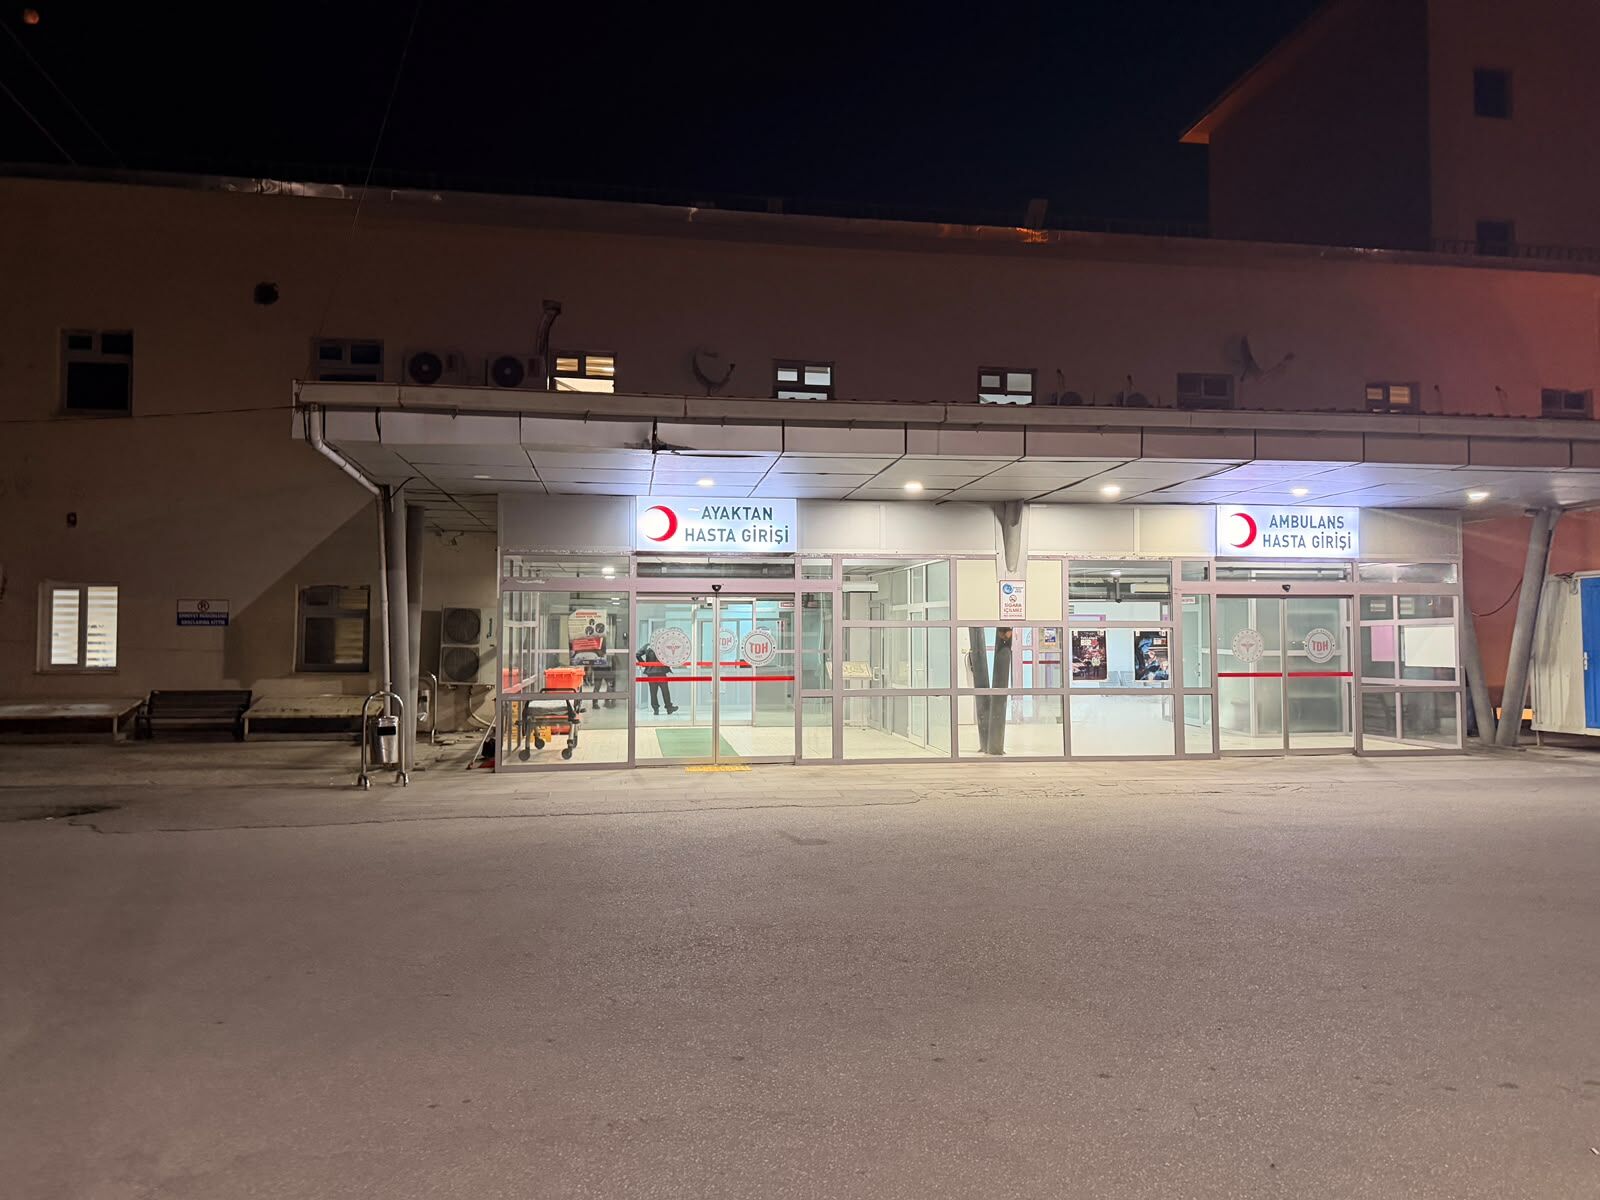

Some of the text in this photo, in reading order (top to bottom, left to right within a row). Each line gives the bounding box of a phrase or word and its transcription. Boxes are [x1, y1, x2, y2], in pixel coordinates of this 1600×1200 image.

[701, 505, 773, 521] AYAKTAN
[1269, 514, 1345, 529] AMBULANS
[685, 525, 789, 544] HASTA GİRİŞİ
[1263, 531, 1352, 550] HASTA GİRİŞİ
[749, 642, 769, 655] TDH
[1312, 639, 1329, 651] TDH
